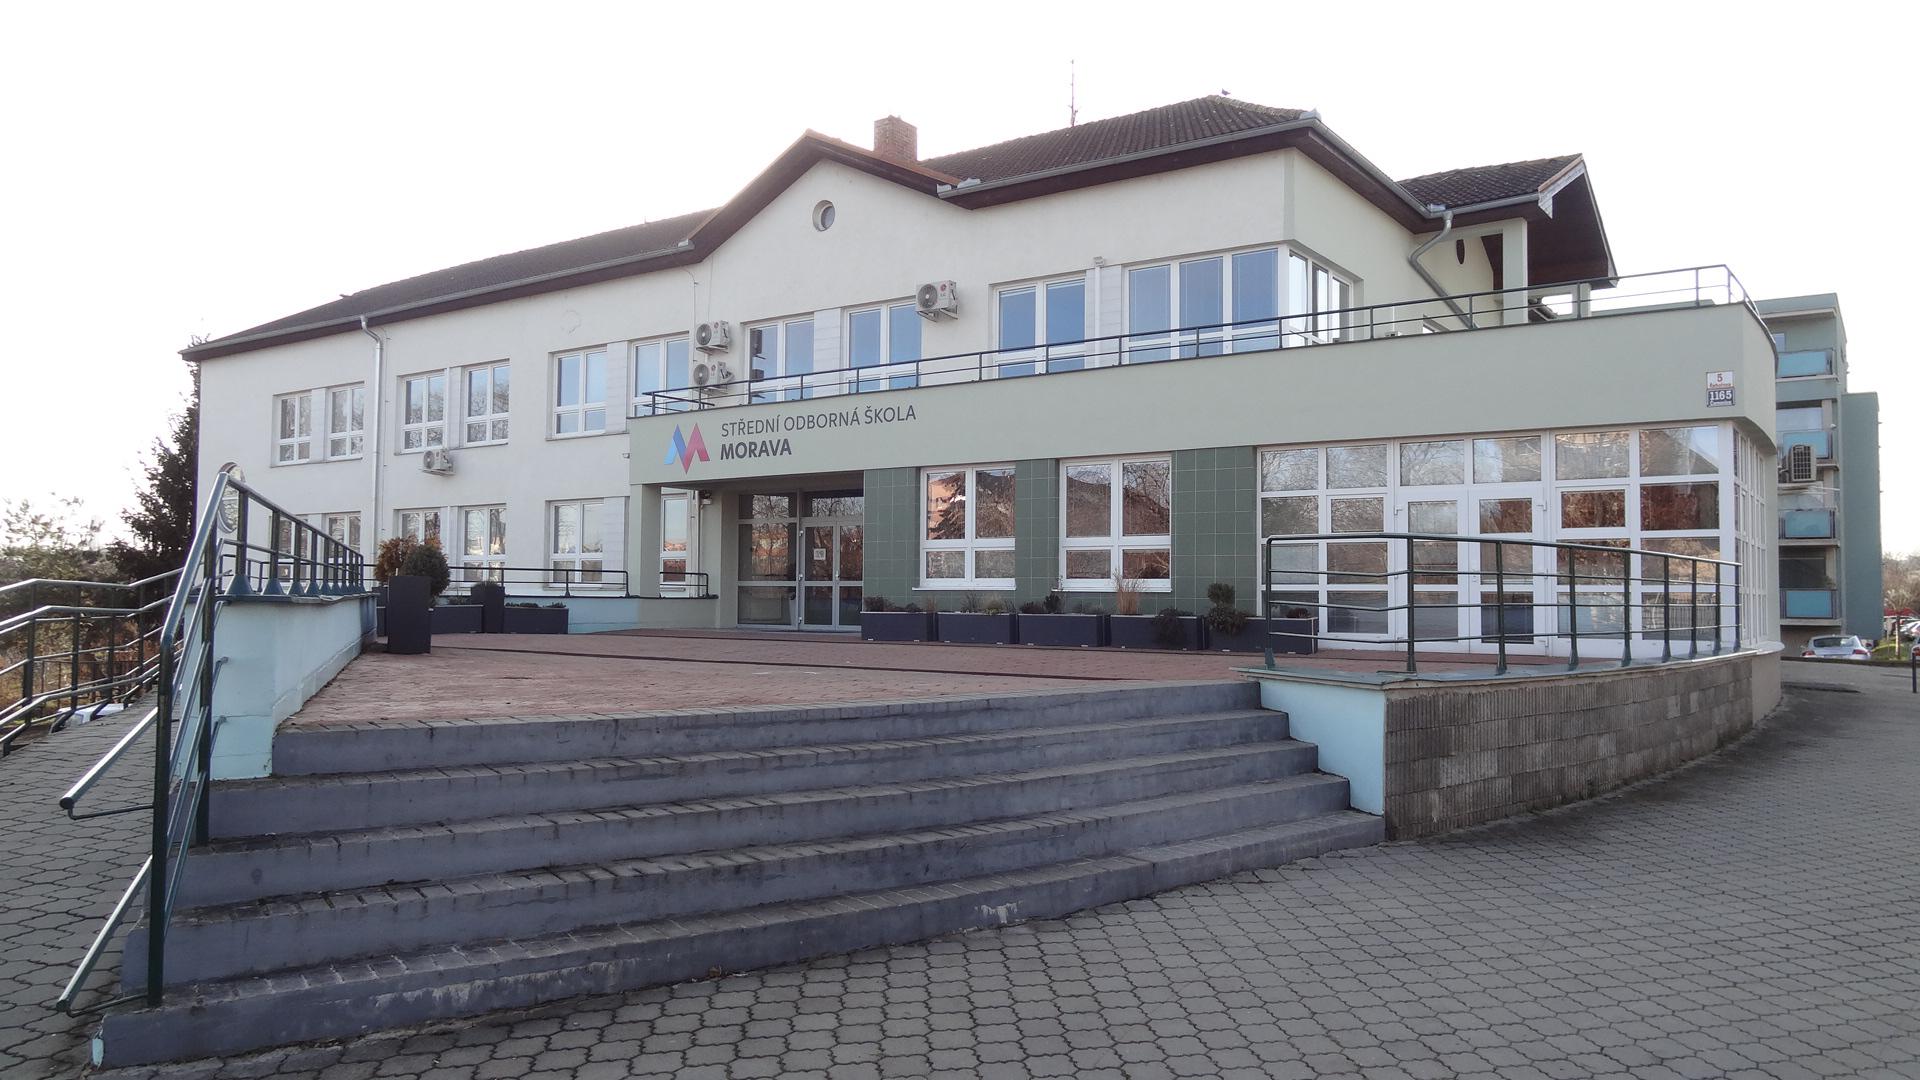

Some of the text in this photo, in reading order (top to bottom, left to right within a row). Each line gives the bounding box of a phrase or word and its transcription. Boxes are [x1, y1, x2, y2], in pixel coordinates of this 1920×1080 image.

[1717, 373, 1723, 382] 5
[1710, 390, 1732, 400] 1165
[721, 405, 917, 437] STŘEDNÍ ODBORNÁ ŠKOLA
[720, 438, 792, 461] MORAVA
